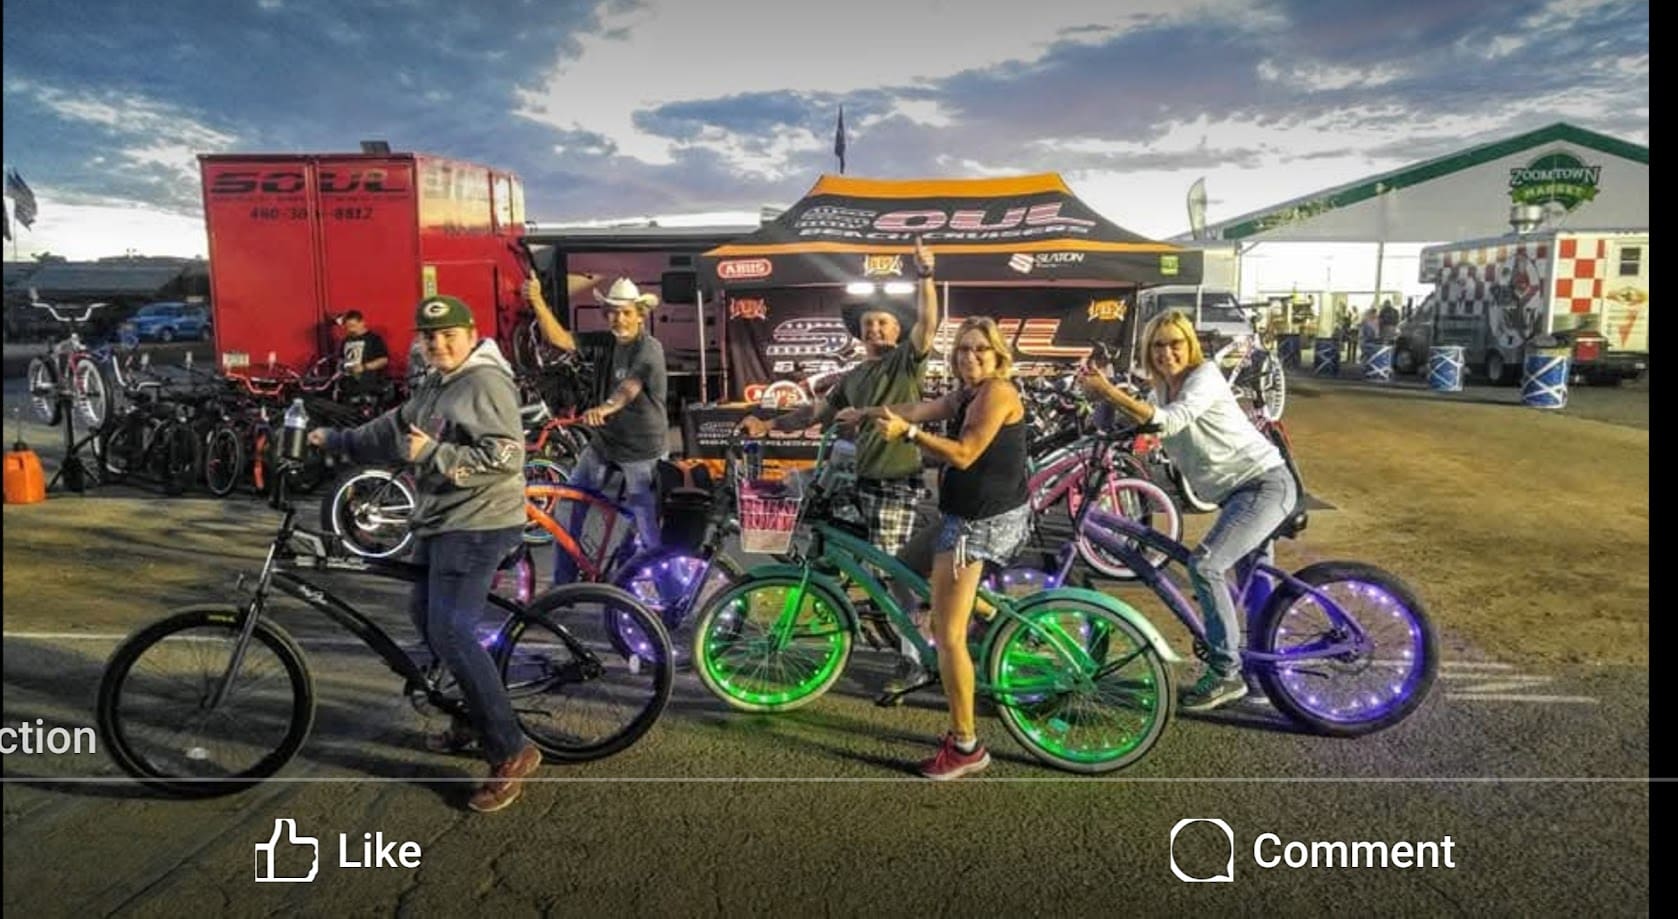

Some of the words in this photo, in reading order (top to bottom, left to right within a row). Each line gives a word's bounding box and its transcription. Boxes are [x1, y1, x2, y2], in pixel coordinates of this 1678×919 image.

[211, 172, 408, 193] SOUL
[1511, 167, 1600, 186] ZOOMTOWN
[1523, 183, 1584, 200] MARKET
[795, 202, 1096, 237] SOUL
[922, 224, 1089, 240] CRUISERS
[726, 263, 766, 275] ABUS
